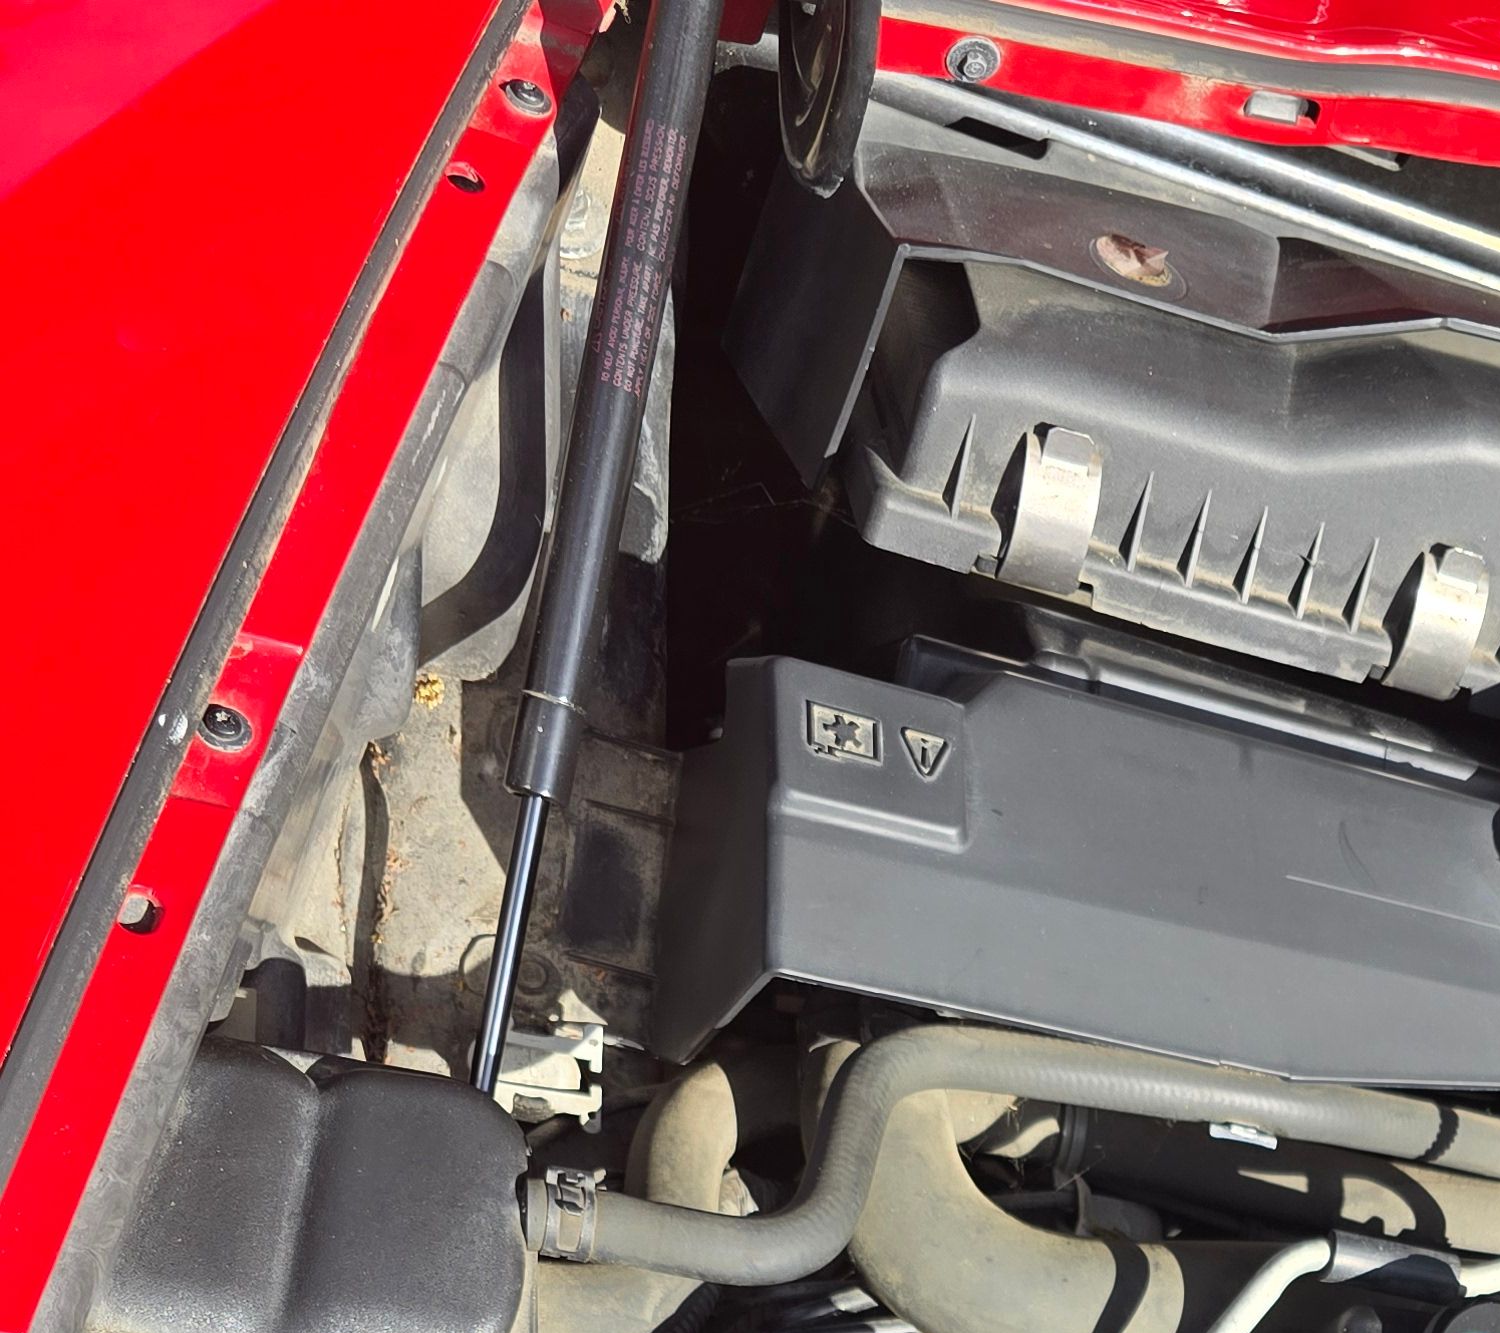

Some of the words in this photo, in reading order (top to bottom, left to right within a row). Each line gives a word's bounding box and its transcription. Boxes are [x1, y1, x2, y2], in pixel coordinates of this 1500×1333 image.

[643, 175, 658, 202] SOUS
[635, 206, 653, 251] CONTENU
[648, 222, 660, 241] PAS
[612, 342, 628, 386] CONTENTS
[620, 309, 634, 339] UNDER
[625, 360, 636, 378] NOT
